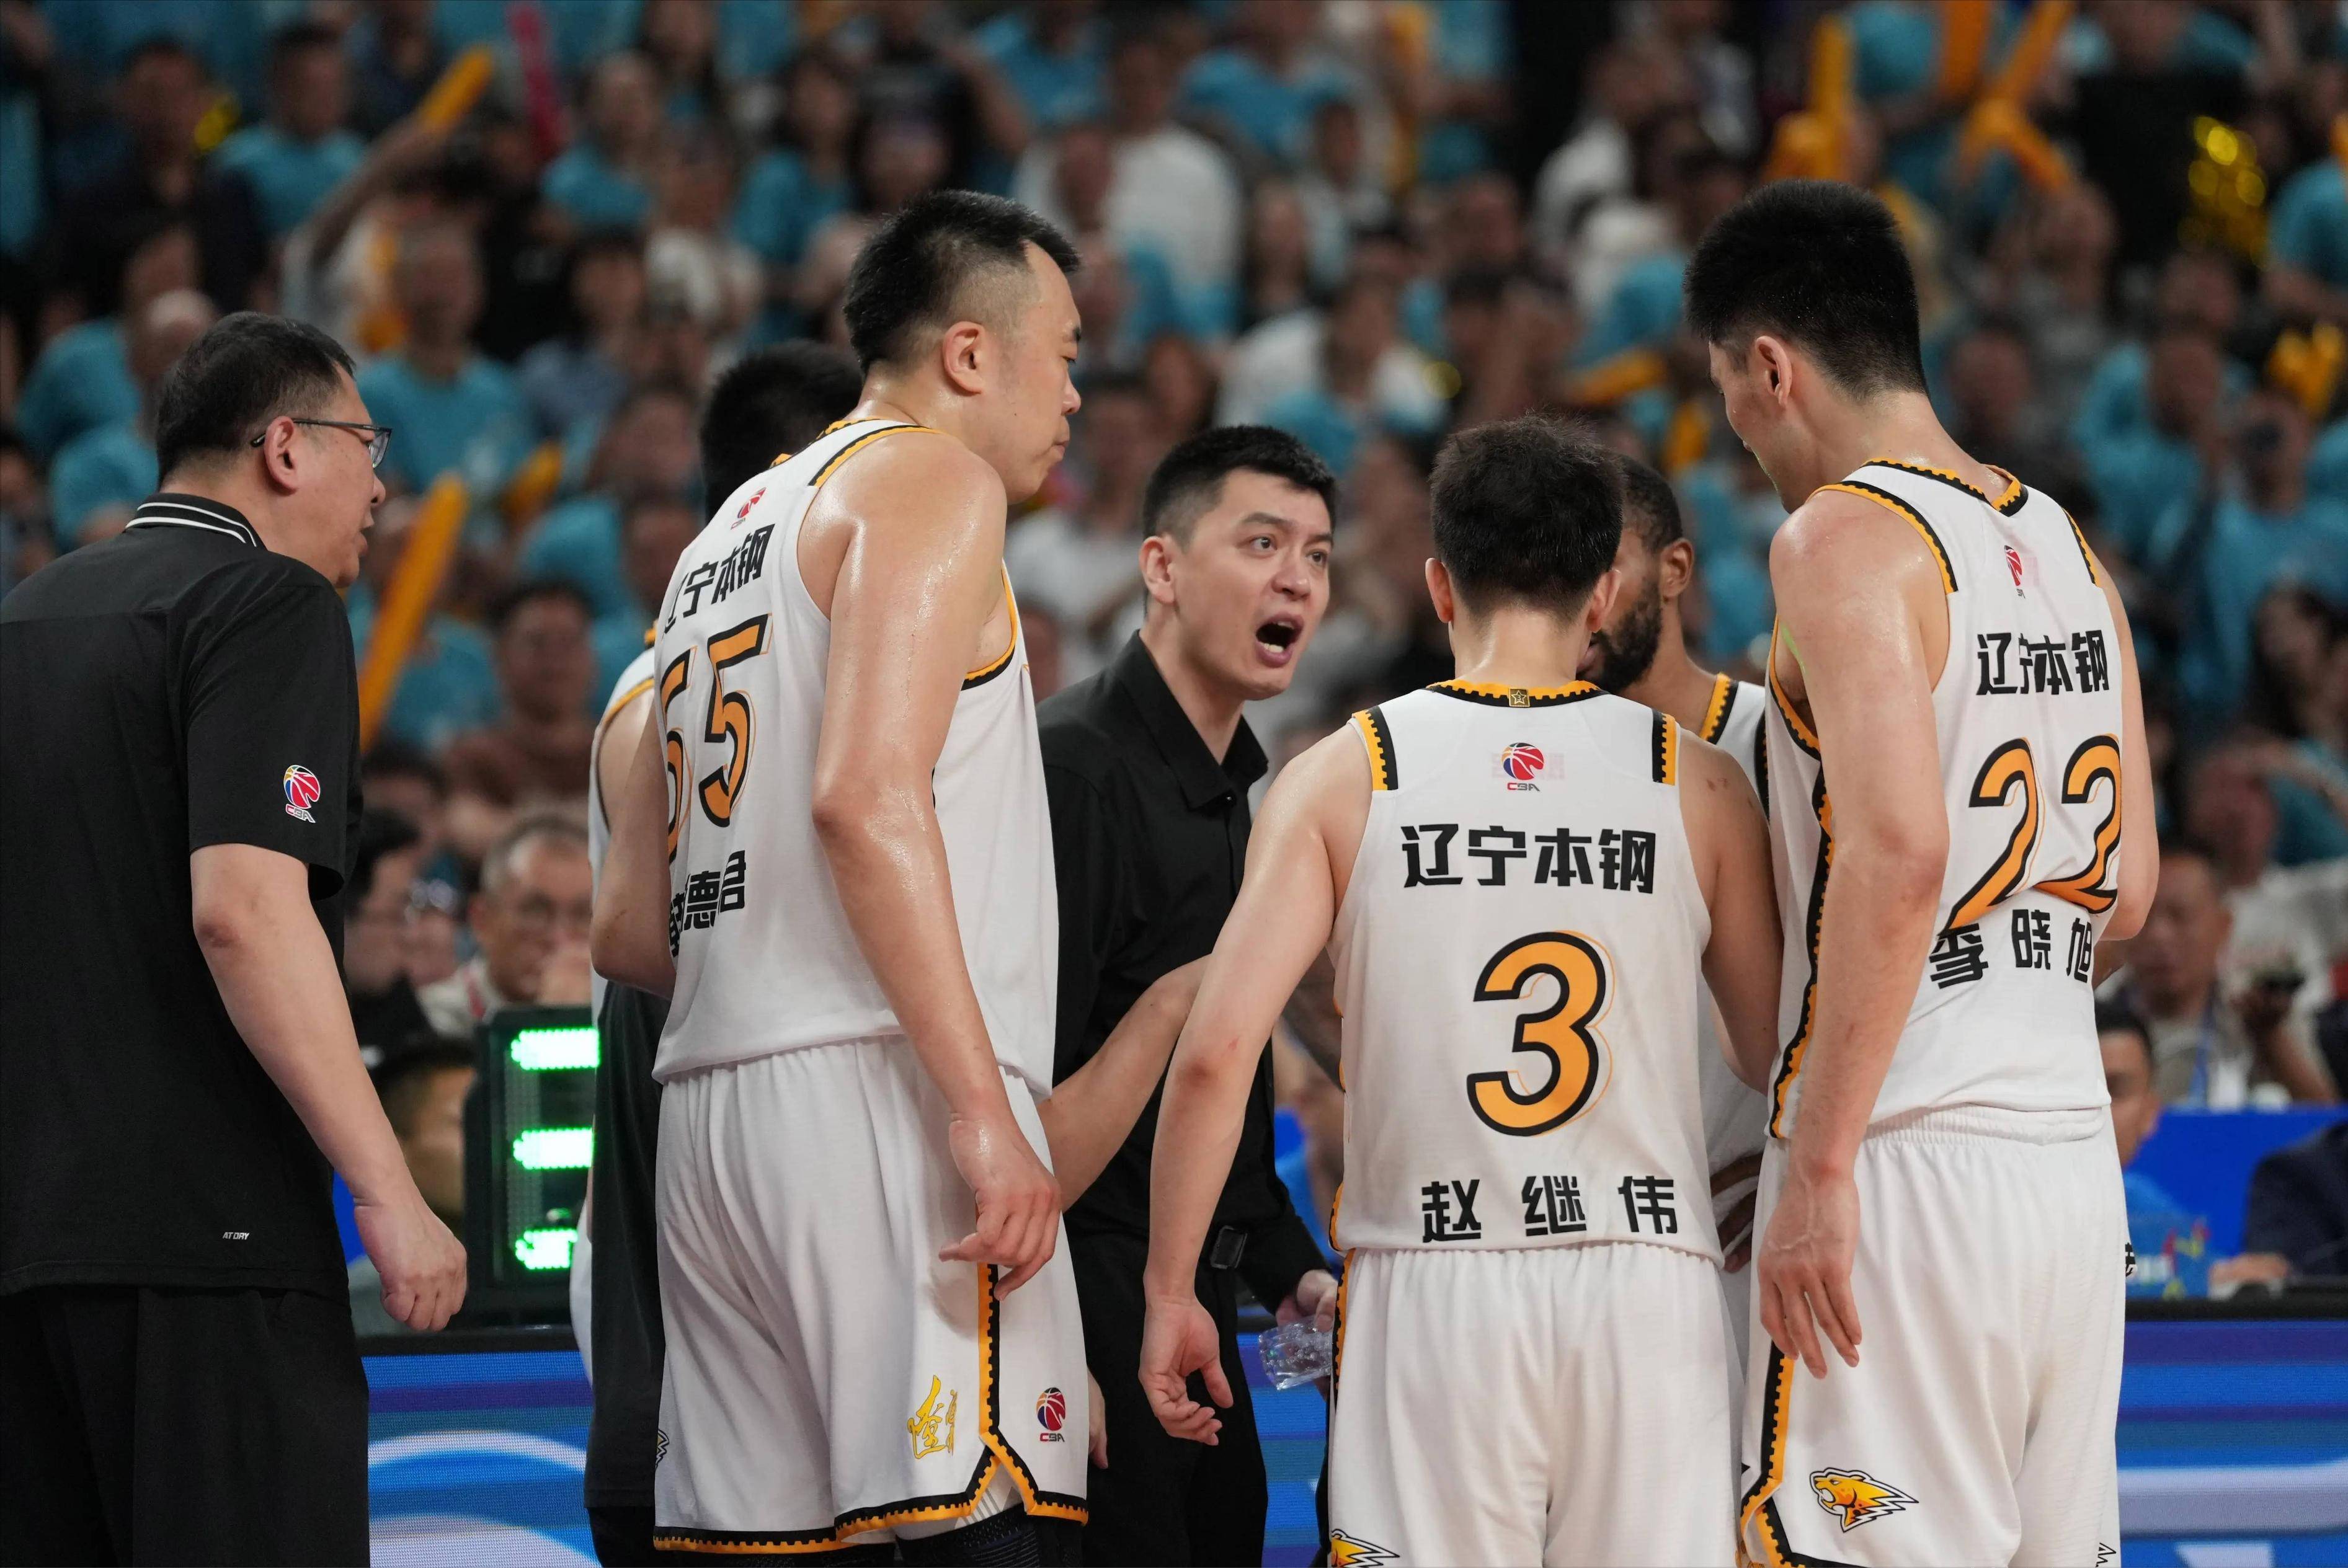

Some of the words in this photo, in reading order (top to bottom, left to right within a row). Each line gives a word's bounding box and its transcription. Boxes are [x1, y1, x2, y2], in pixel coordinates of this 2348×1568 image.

[1977, 630, 2110, 696] 辽宁本钢
[285, 804, 316, 823] CBA
[1507, 782, 1541, 792] CBA
[1400, 823, 1656, 894] 辽宁本钢
[1946, 733, 2122, 931] 22
[1929, 909, 2092, 989] 李晓旭
[1466, 929, 1614, 1138] 3
[1421, 1176, 1678, 1243] 赵继伟
[1039, 1433, 1065, 1442] CBA
